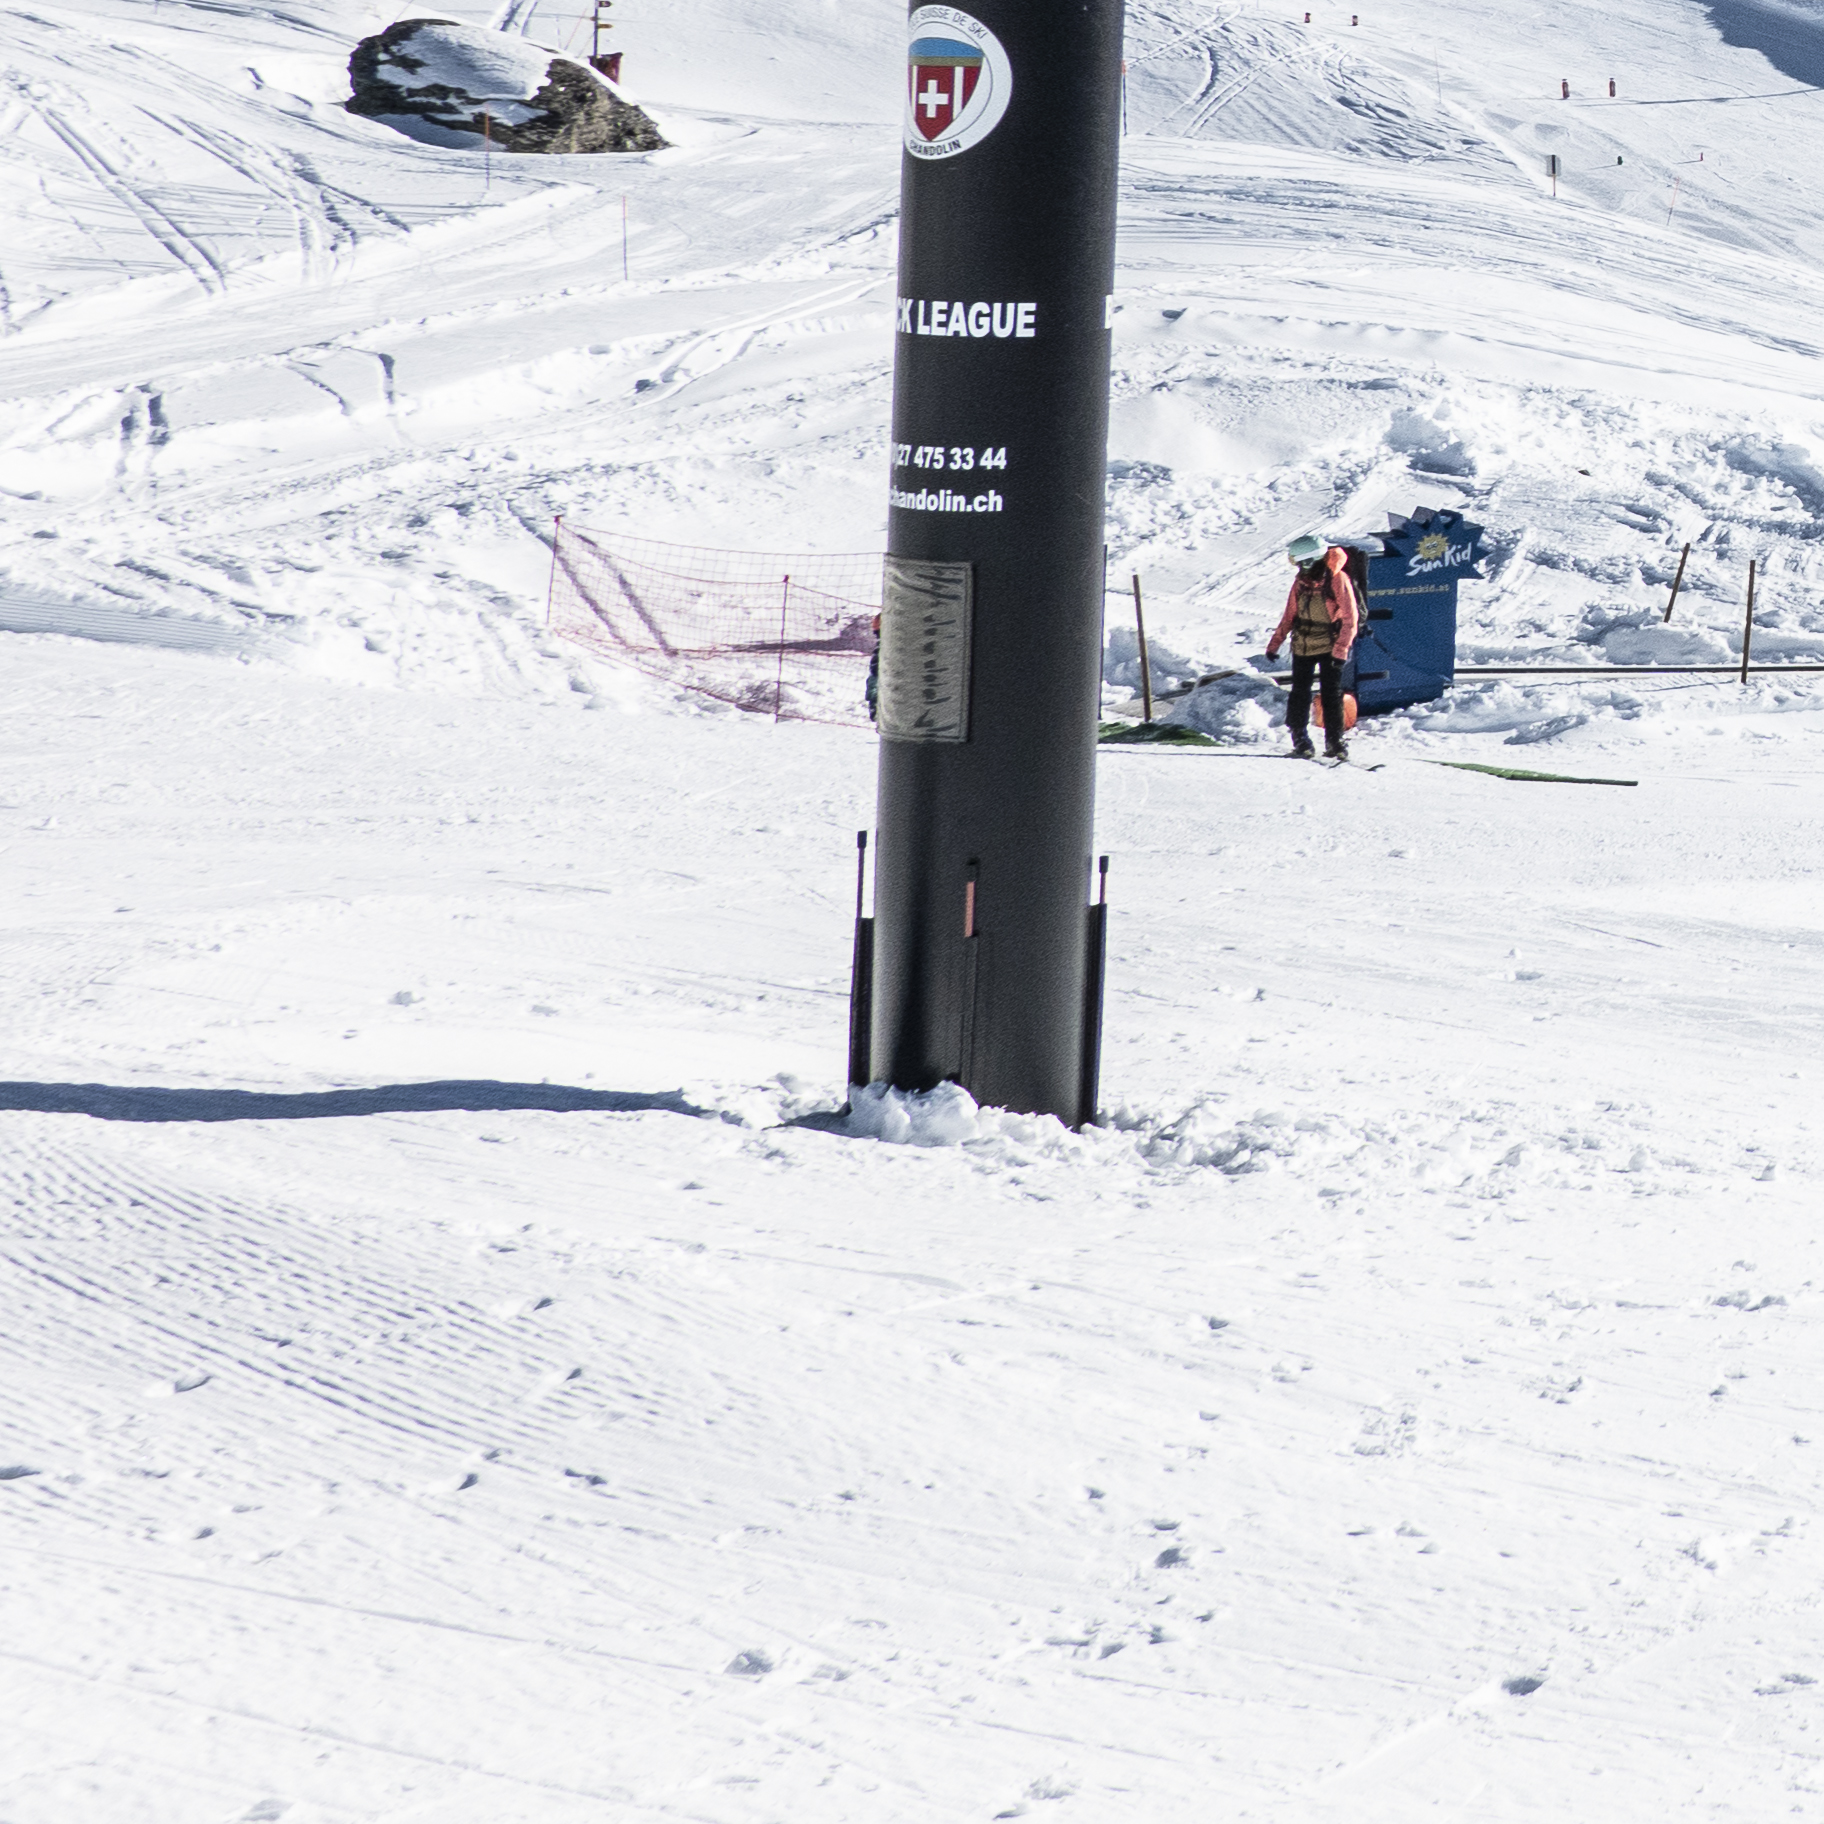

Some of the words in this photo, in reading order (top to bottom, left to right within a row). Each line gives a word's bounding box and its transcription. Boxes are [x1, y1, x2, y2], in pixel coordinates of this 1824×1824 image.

[952, 11, 968, 27] DE
[967, 21, 989, 40] SKI
[916, 299, 1038, 338] LEAGUE
[914, 445, 945, 469] 475
[949, 447, 975, 470] 33
[979, 446, 1007, 470] 44
